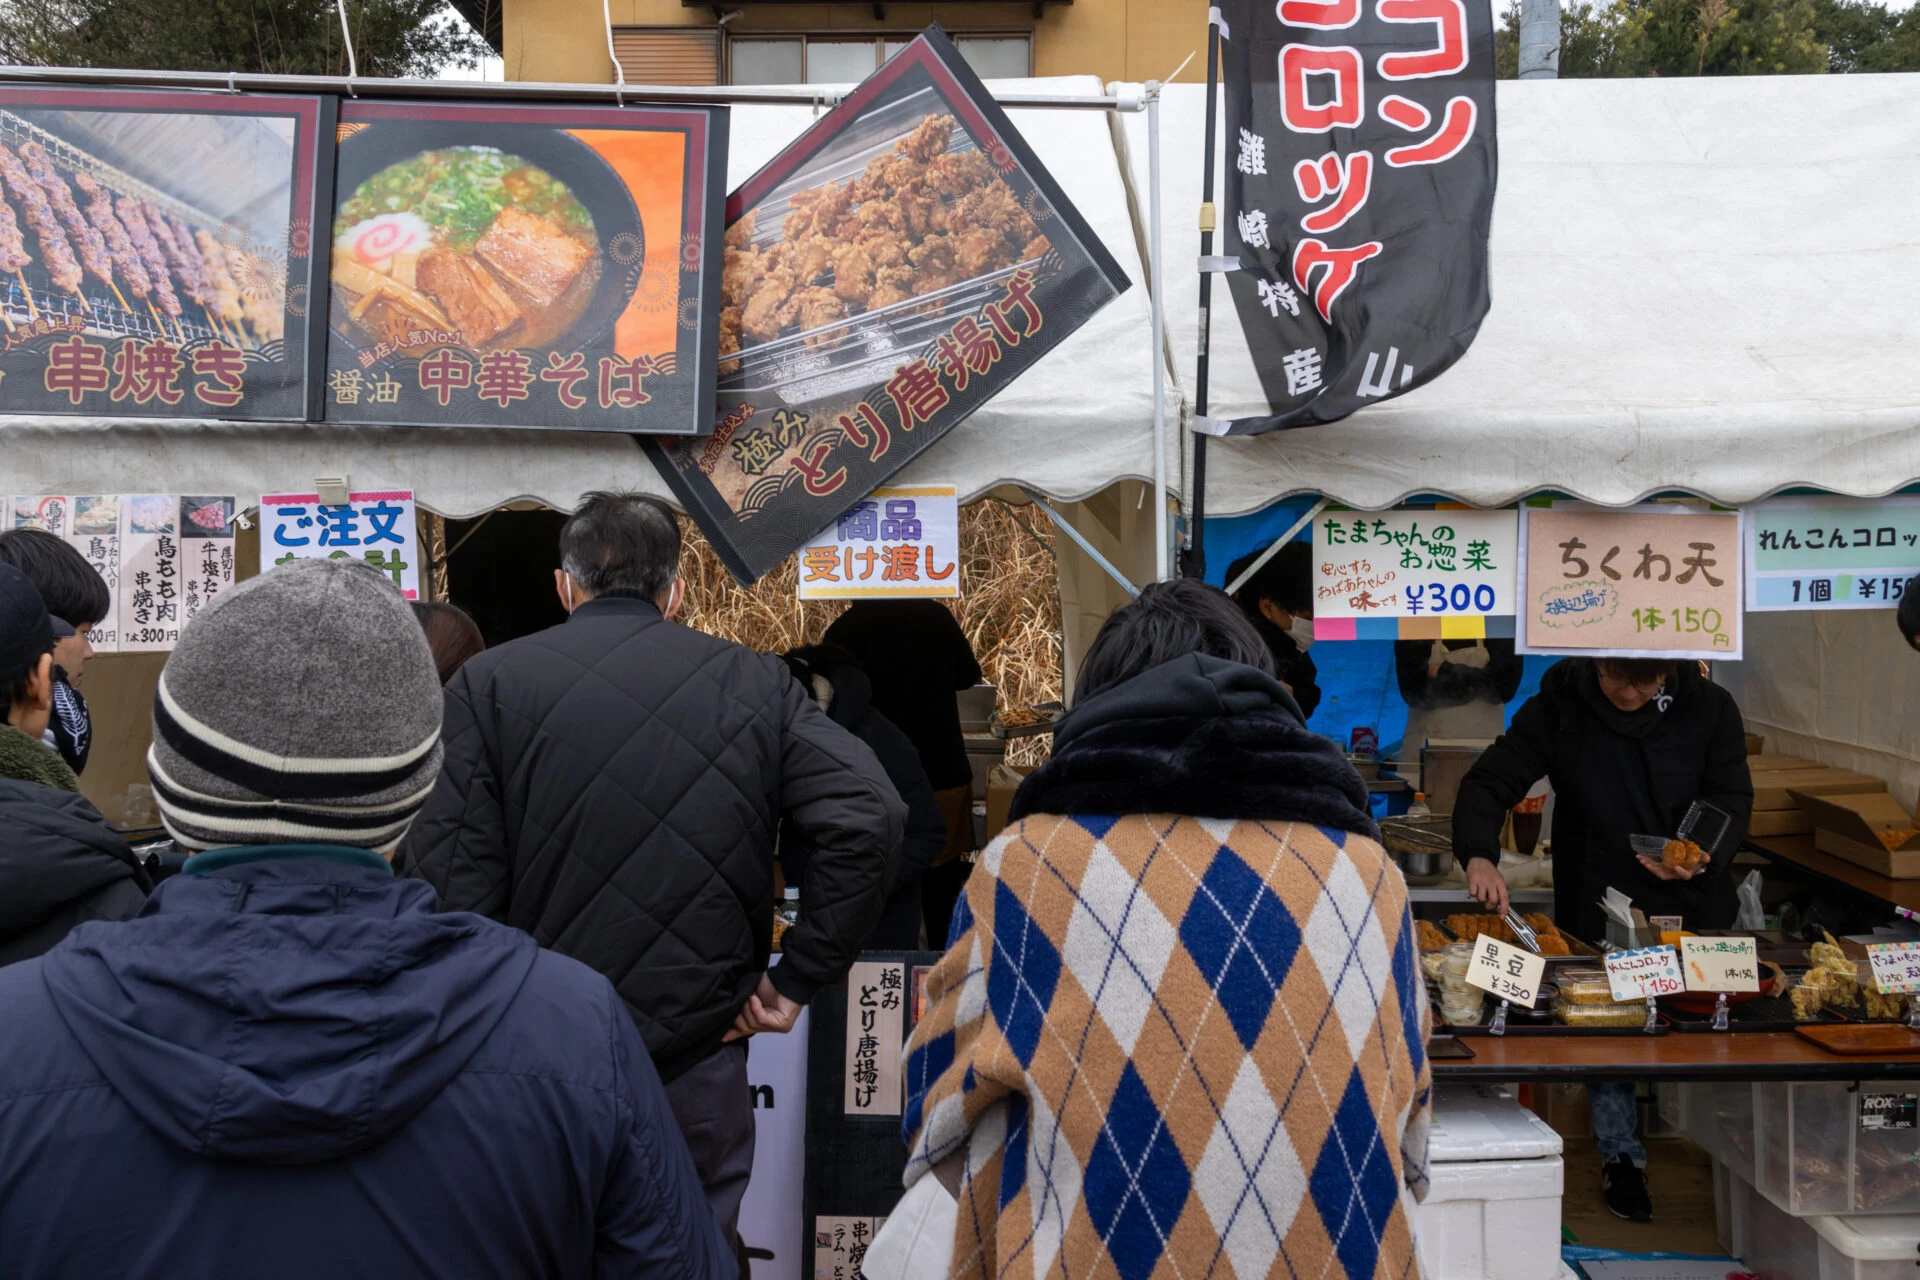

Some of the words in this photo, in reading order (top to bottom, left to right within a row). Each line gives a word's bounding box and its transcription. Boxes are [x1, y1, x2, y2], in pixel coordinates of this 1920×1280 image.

[1277, 0, 1383, 325] ロッケ
[45, 334, 248, 407] 串焼き
[327, 368, 403, 406] 醤油
[419, 349, 657, 409] 中華そば
[732, 408, 810, 475] 極み
[790, 270, 1044, 496] とり唐揚げ
[274, 501, 405, 547] ご注文
[837, 500, 922, 541] 商品
[1323, 518, 1456, 548] たまちゃんの
[1758, 526, 1919, 551] れんこんコロッ
[803, 543, 955, 582] 受け渡し
[1321, 559, 1371, 577] 安心する
[1399, 540, 1497, 572] お惣菜
[1558, 536, 1724, 587] ちくわ天
[132, 571, 154, 624] 串焼き
[155, 535, 178, 622] 鳥もも肉
[1405, 582, 1496, 615] ¥300
[1480, 943, 1525, 978] 黒豆
[880, 968, 902, 1010] 極み
[1491, 974, 1531, 1001] ¥350
[853, 985, 880, 1108] とり唐揚げ
